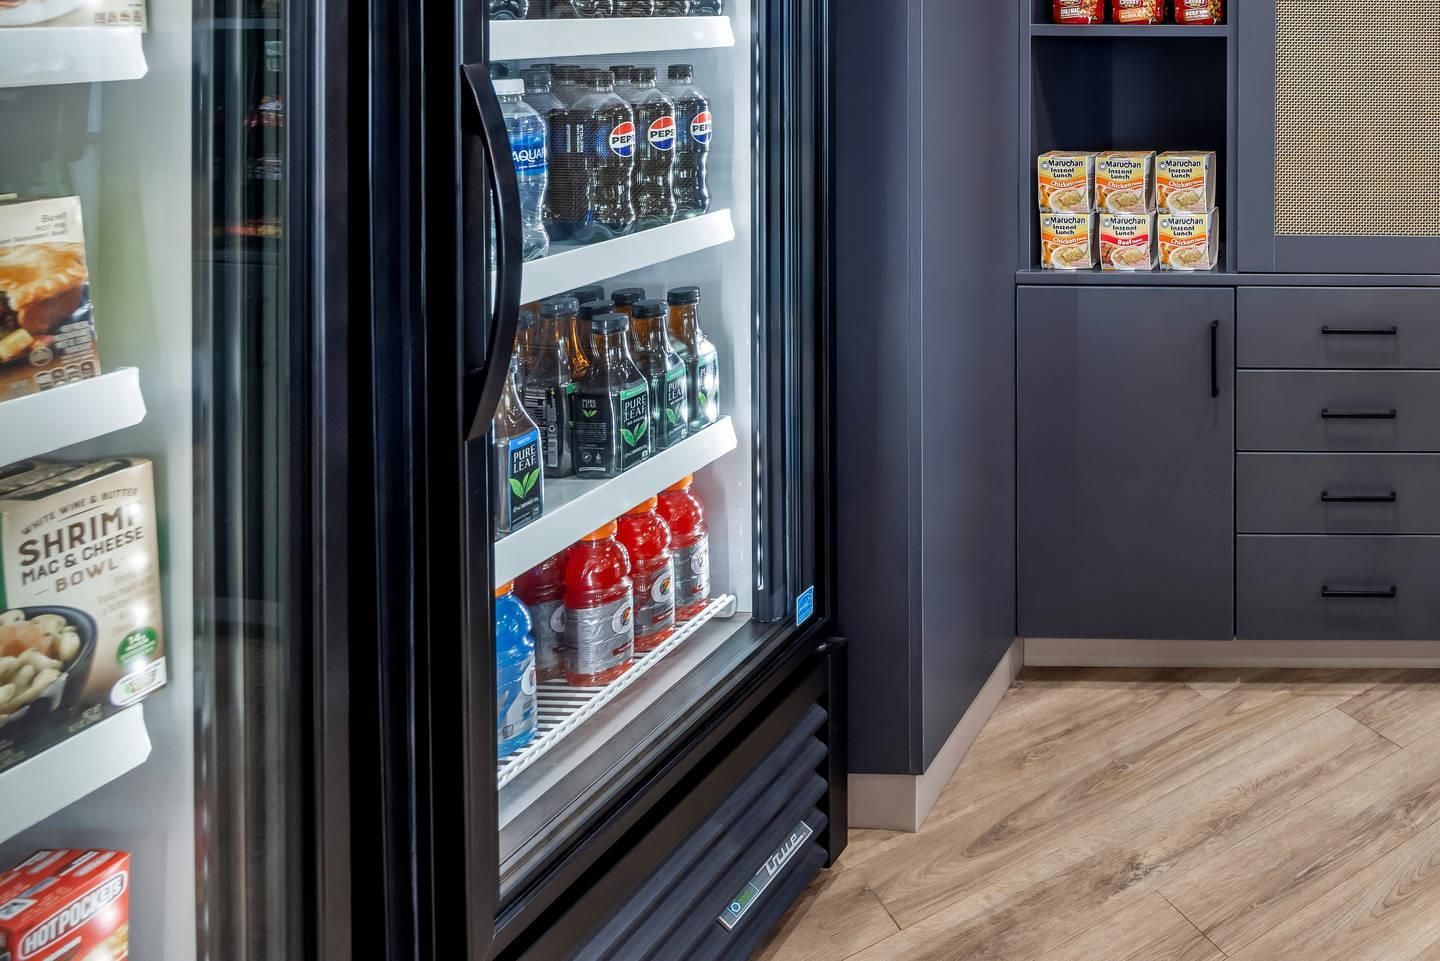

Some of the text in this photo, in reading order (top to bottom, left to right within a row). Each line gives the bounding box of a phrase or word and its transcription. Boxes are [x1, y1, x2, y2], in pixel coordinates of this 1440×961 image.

[512, 149, 546, 163] AQUA
[1106, 161, 1141, 169] Maruchan
[1168, 181, 1192, 189] Chicken
[1168, 218, 1204, 226] Maruchan
[1170, 239, 1195, 247] Chicken
[625, 394, 647, 412] PURE
[668, 389, 683, 401] LEA
[624, 403, 647, 422] LEAF
[513, 443, 537, 463] PURE
[513, 454, 537, 474] LEAF
[22, 511, 56, 535] WHITE
[60, 498, 86, 514] WINE
[22, 526, 144, 586] MAC & CHEESE
[55, 558, 118, 593] BOWL
[755, 833, 804, 876] True
